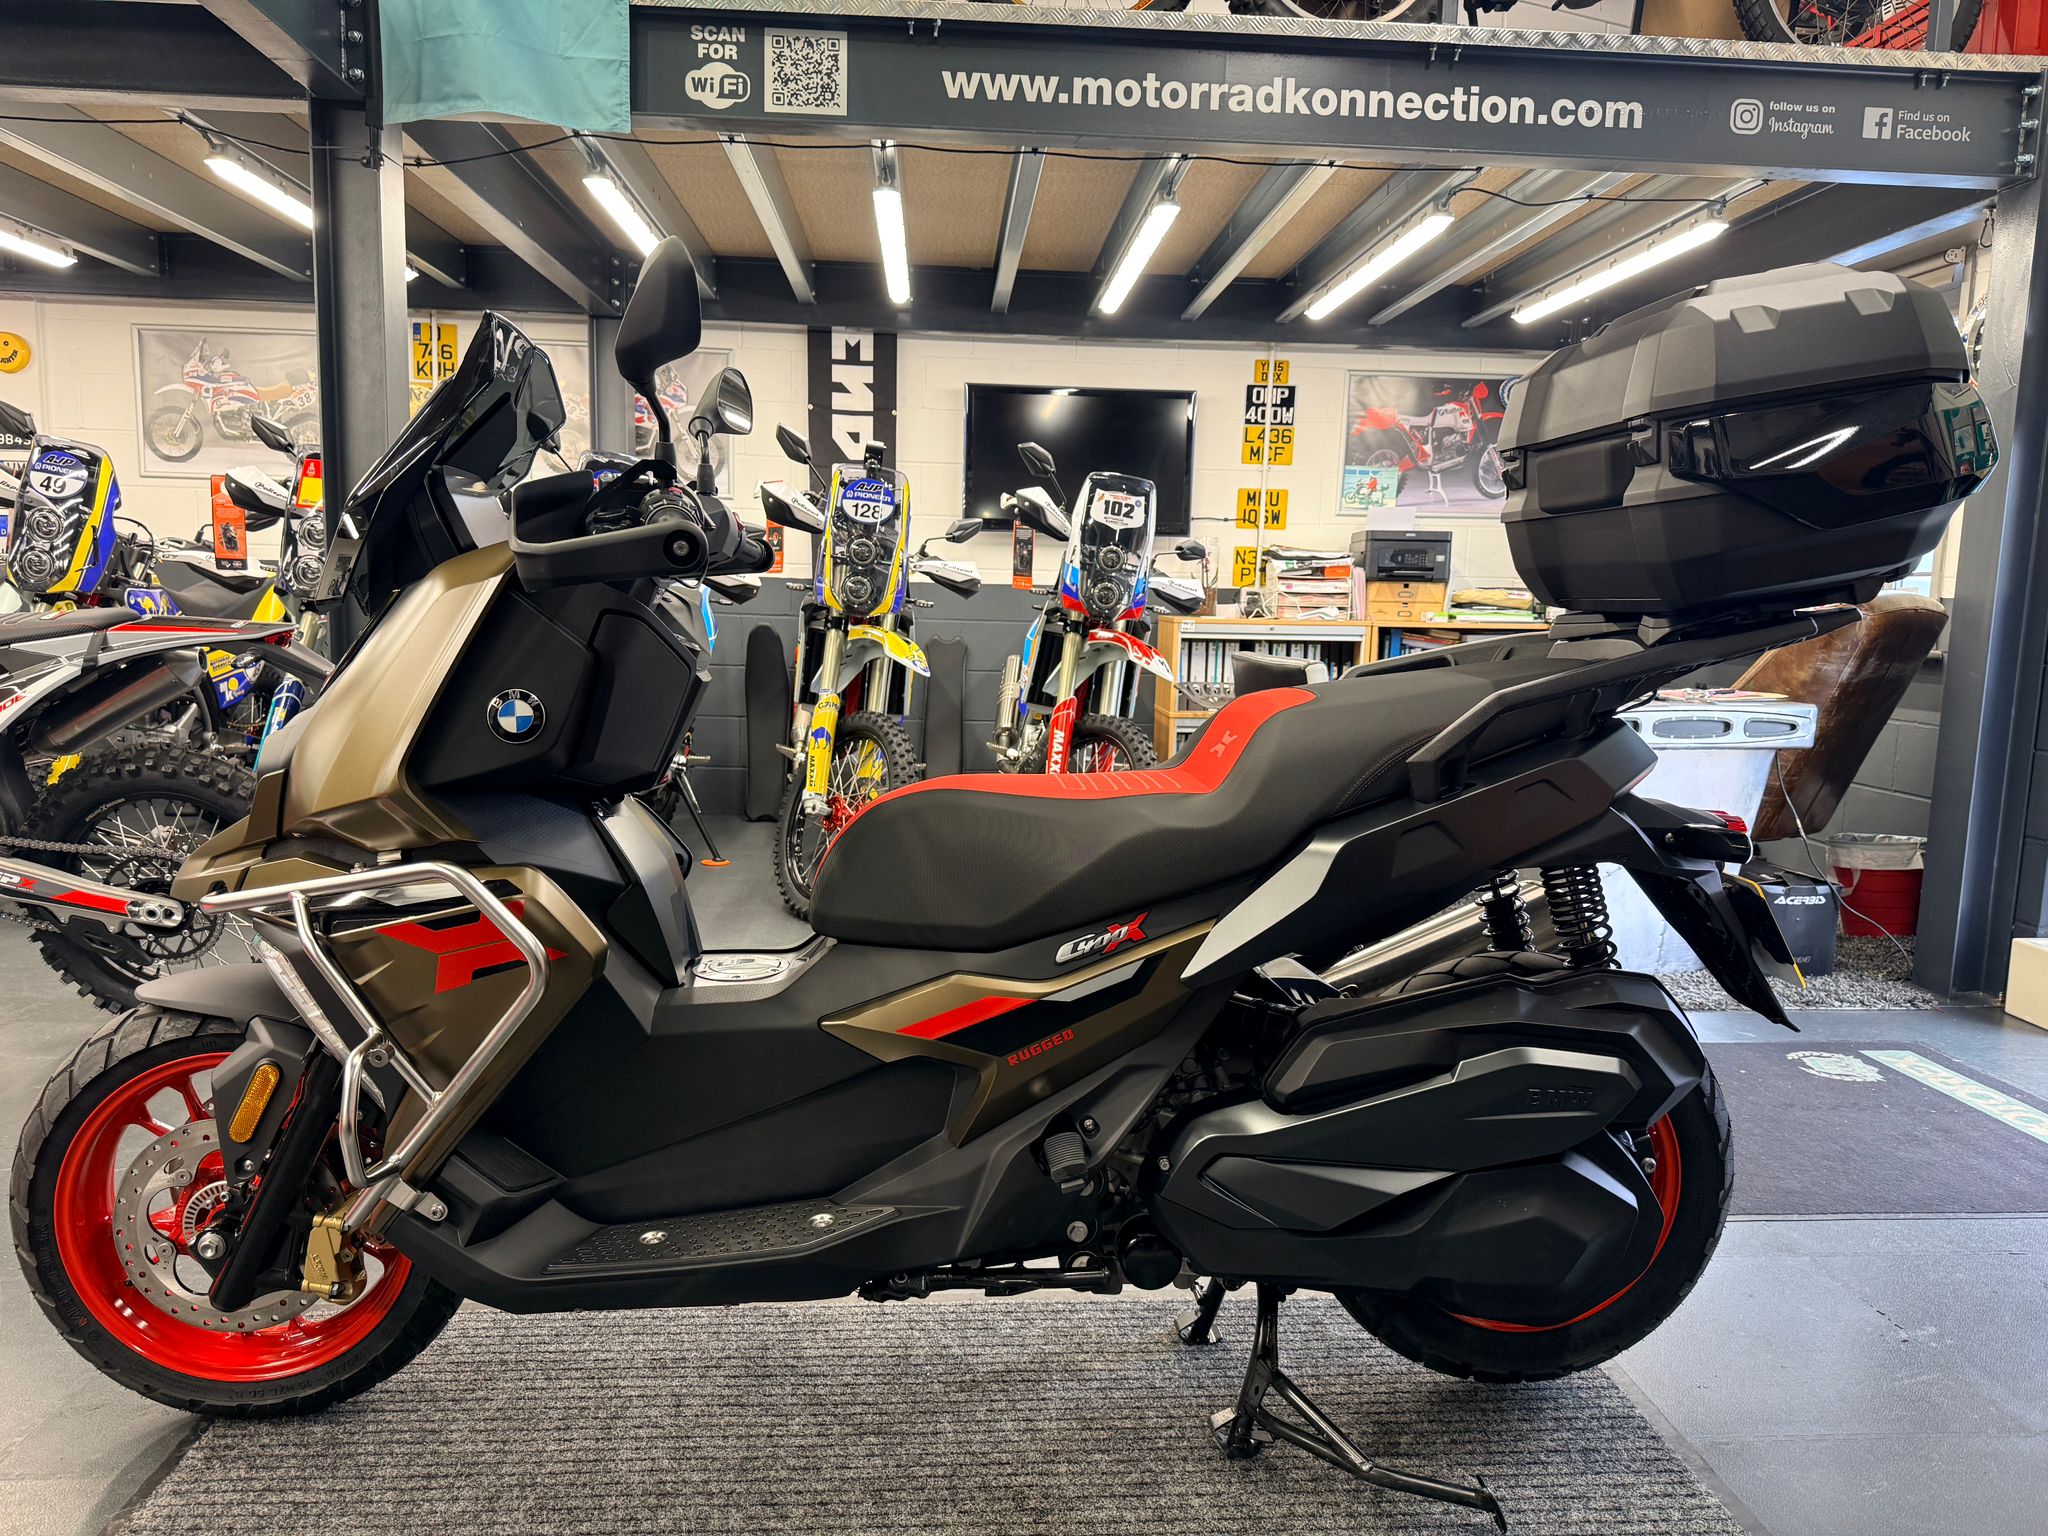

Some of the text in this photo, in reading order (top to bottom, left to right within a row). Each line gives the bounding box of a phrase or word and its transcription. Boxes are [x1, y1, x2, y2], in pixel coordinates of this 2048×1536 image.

[690, 25, 746, 43] SCAN
[697, 43, 738, 60] FOR
[941, 71, 1643, 129] www.motorradkonnection.com
[1769, 101, 1836, 114] follow us on
[1898, 110, 1950, 123] Find us on
[1768, 116, 1834, 140] Instagram
[1897, 124, 1971, 143] Facebook
[1260, 361, 1284, 372] Y15
[1261, 371, 1282, 382] DX
[1245, 405, 1294, 424] 400W
[43, 455, 76, 466] AJP
[39, 475, 67, 493] 49
[856, 482, 884, 492] AJP
[853, 491, 892, 502] PIONEER
[852, 503, 883, 520] 128
[1103, 499, 1136, 520] 102
[491, 689, 541, 709] BMW
[0, 871, 39, 889] PX
[1007, 1028, 1075, 1067] RUGGED
